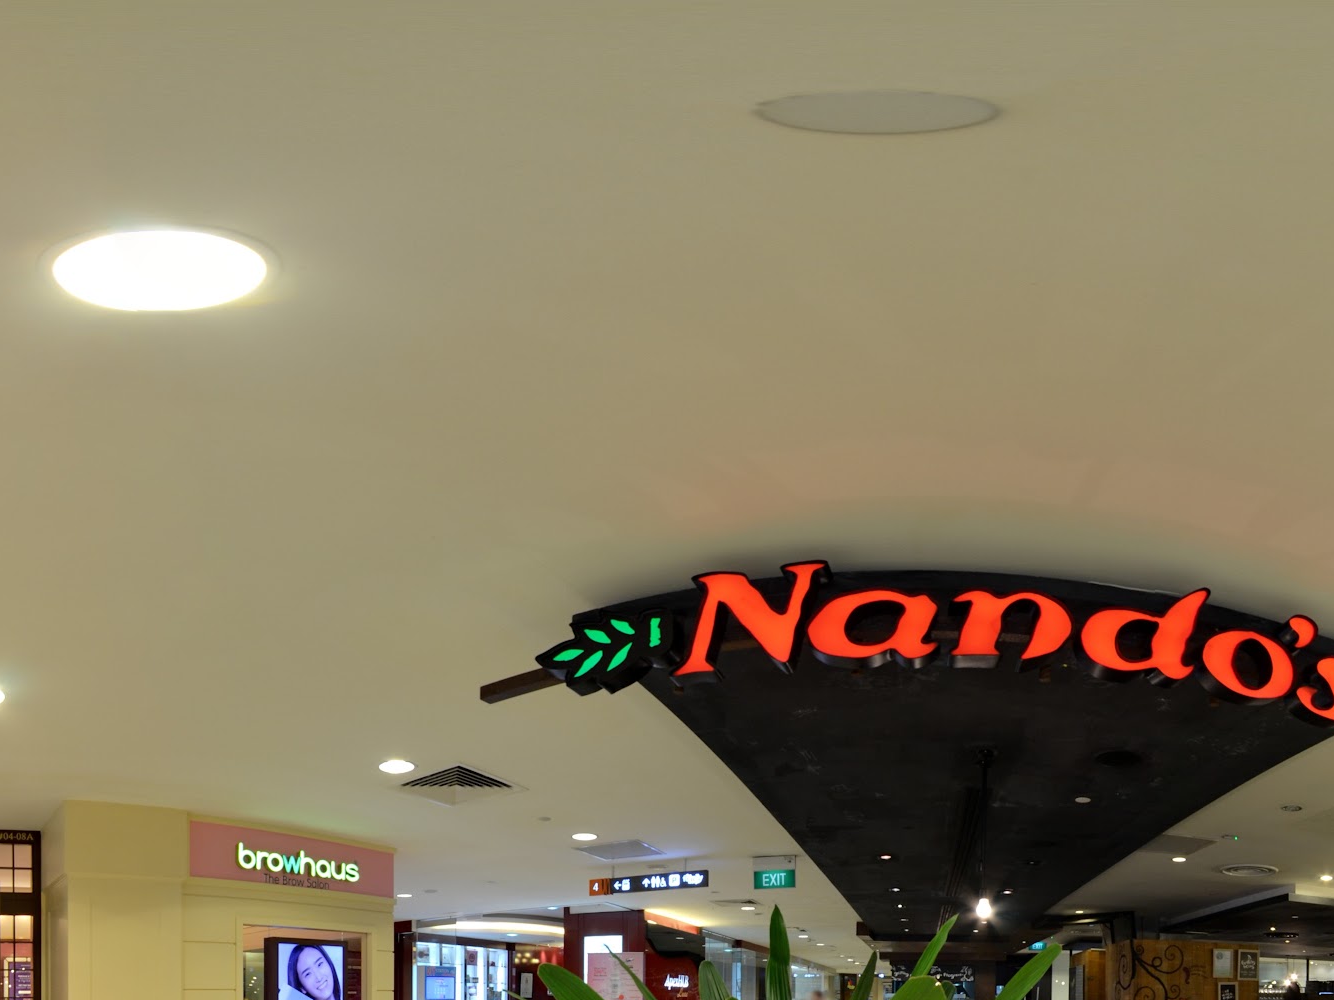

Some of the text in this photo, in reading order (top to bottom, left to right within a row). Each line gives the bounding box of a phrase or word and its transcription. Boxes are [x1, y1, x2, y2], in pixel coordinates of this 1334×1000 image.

[237, 841, 360, 883] browhaus
[263, 873, 330, 890] The Brow Salon
[592, 883, 599, 891] 4
[762, 873, 786, 887] EXIT
